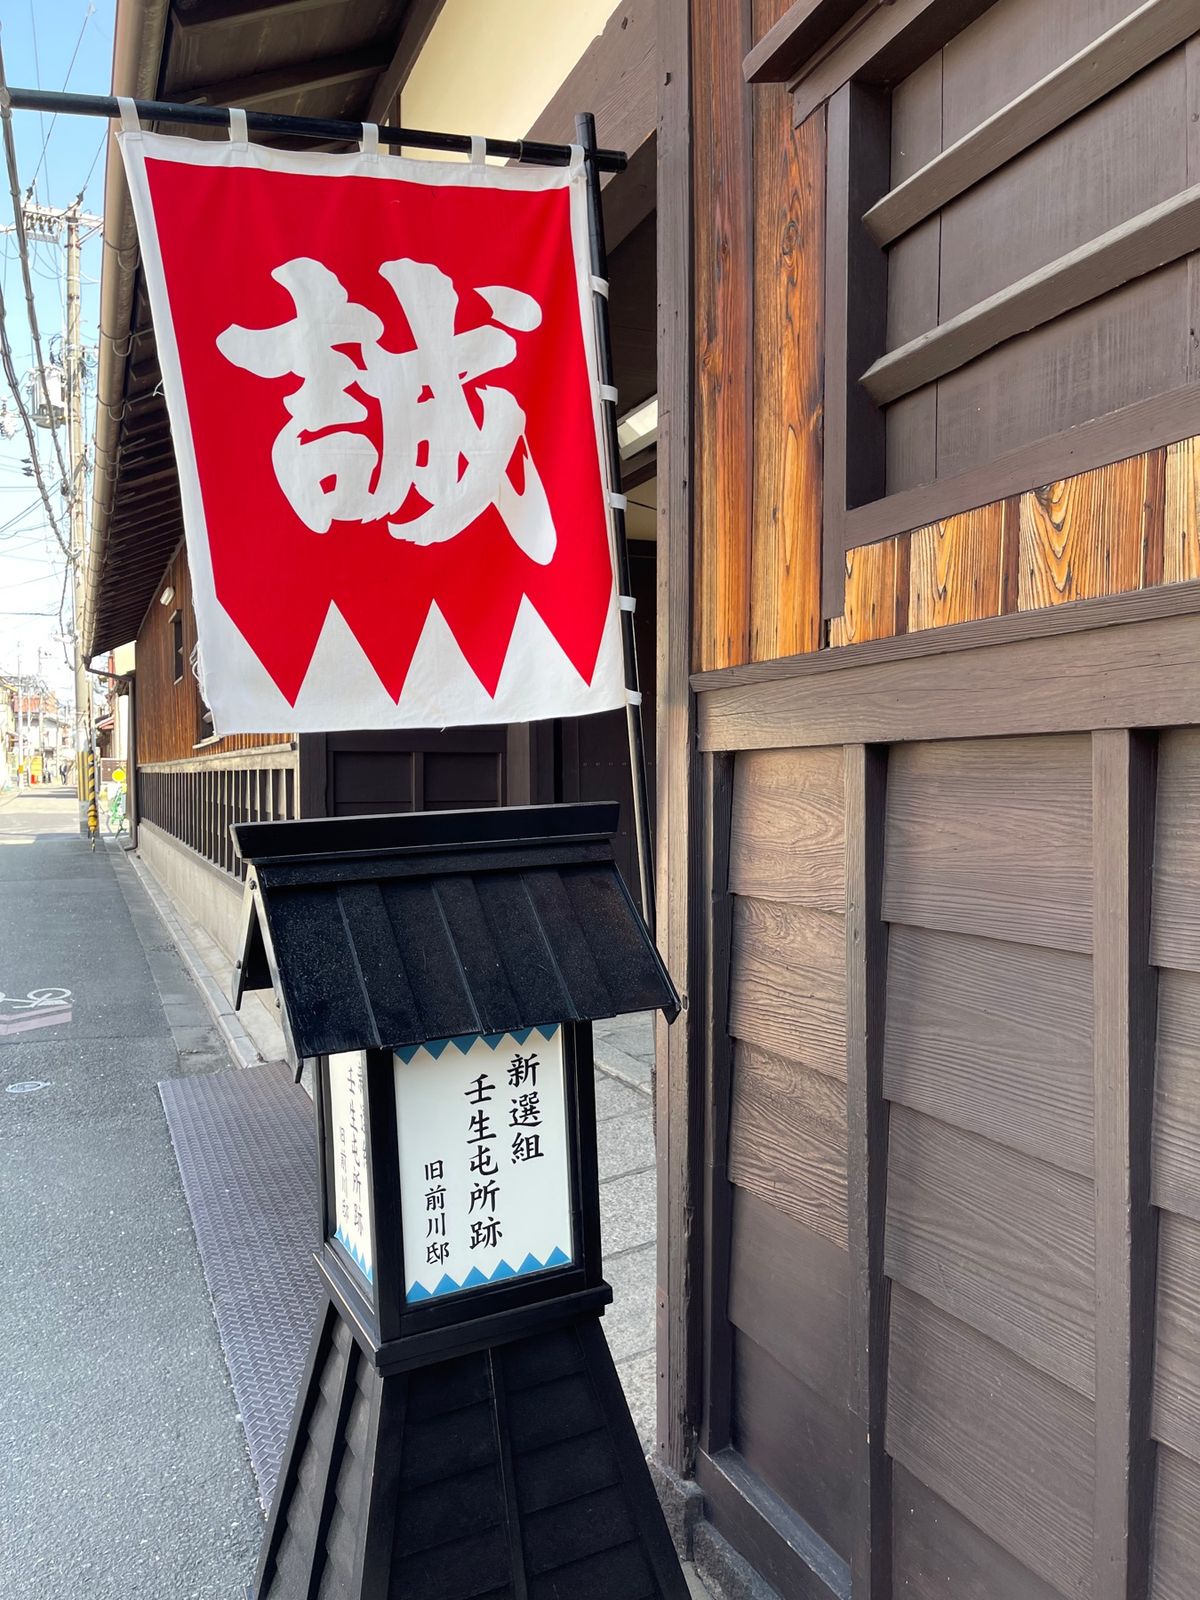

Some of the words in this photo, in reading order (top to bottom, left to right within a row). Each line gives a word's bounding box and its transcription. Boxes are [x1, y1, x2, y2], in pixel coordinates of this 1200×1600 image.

[216, 256, 558, 566] 誠
[464, 1074, 503, 1250] 壬生屯所跡
[507, 1053, 544, 1165] 新選組
[424, 1159, 450, 1266] 旧前川邸
